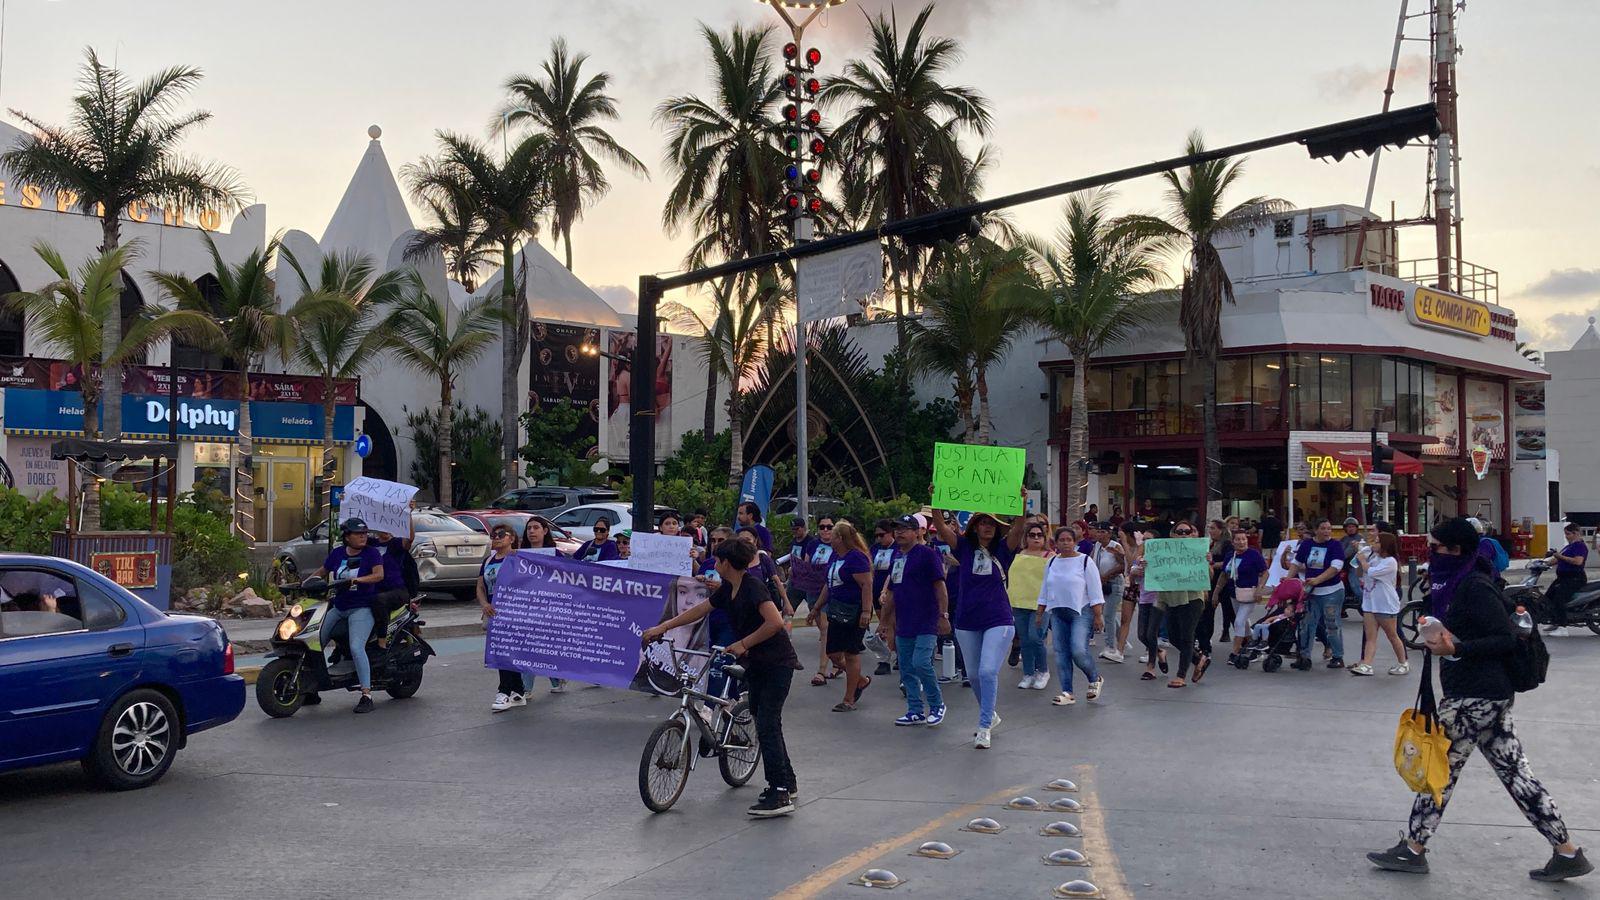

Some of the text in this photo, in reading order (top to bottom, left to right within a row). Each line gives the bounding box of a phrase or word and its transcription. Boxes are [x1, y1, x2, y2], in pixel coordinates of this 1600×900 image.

[1371, 283, 1405, 311] TACOS
[1423, 296, 1432, 315] EL
[1435, 299, 1463, 322] COMPA
[1465, 309, 1484, 329] PITY
[59, 406, 85, 415] Helad
[145, 401, 234, 430] Dolphy
[282, 416, 313, 425] Helados
[27, 472, 56, 485] DOBLES
[935, 463, 1009, 485] POR ANA
[115, 557, 135, 570] TIKI
[116, 570, 134, 585] BAR
[518, 559, 663, 599] Soy ANA BEATRIZ
[538, 590, 573, 600] FEMINICIDIO
[512, 659, 558, 671] EXIGO JUSTICIA
